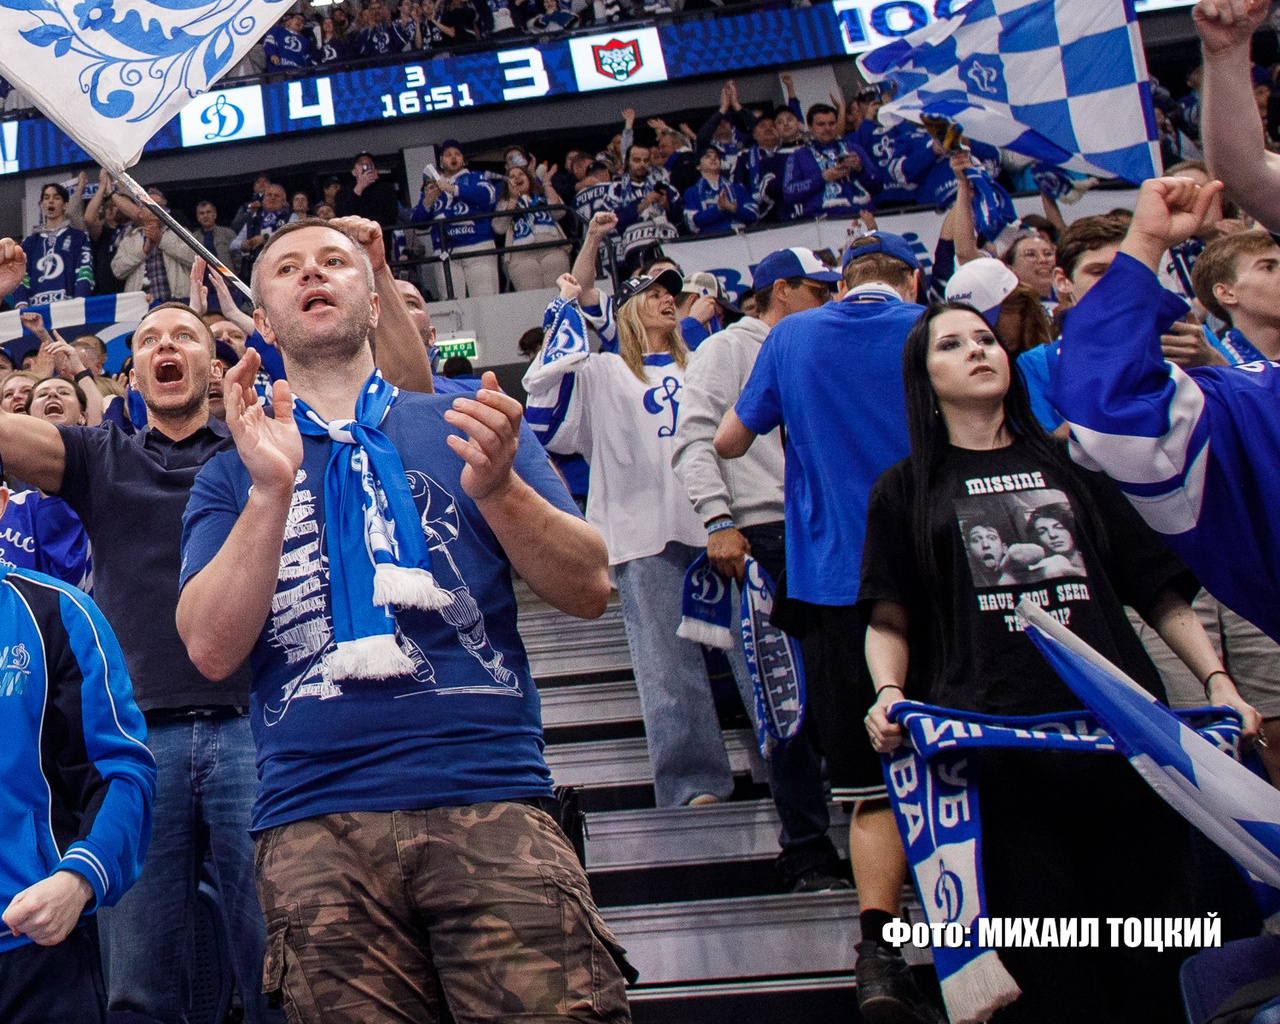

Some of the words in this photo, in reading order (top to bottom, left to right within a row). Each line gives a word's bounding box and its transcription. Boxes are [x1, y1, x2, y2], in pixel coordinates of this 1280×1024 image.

[406, 65, 426, 88] 3
[496, 46, 550, 101] 3
[287, 77, 336, 126] 4
[381, 82, 474, 118] 16:51
[965, 471, 1046, 495] MISSING
[977, 593, 1015, 611] HAVE
[1056, 583, 1090, 602] SEEN
